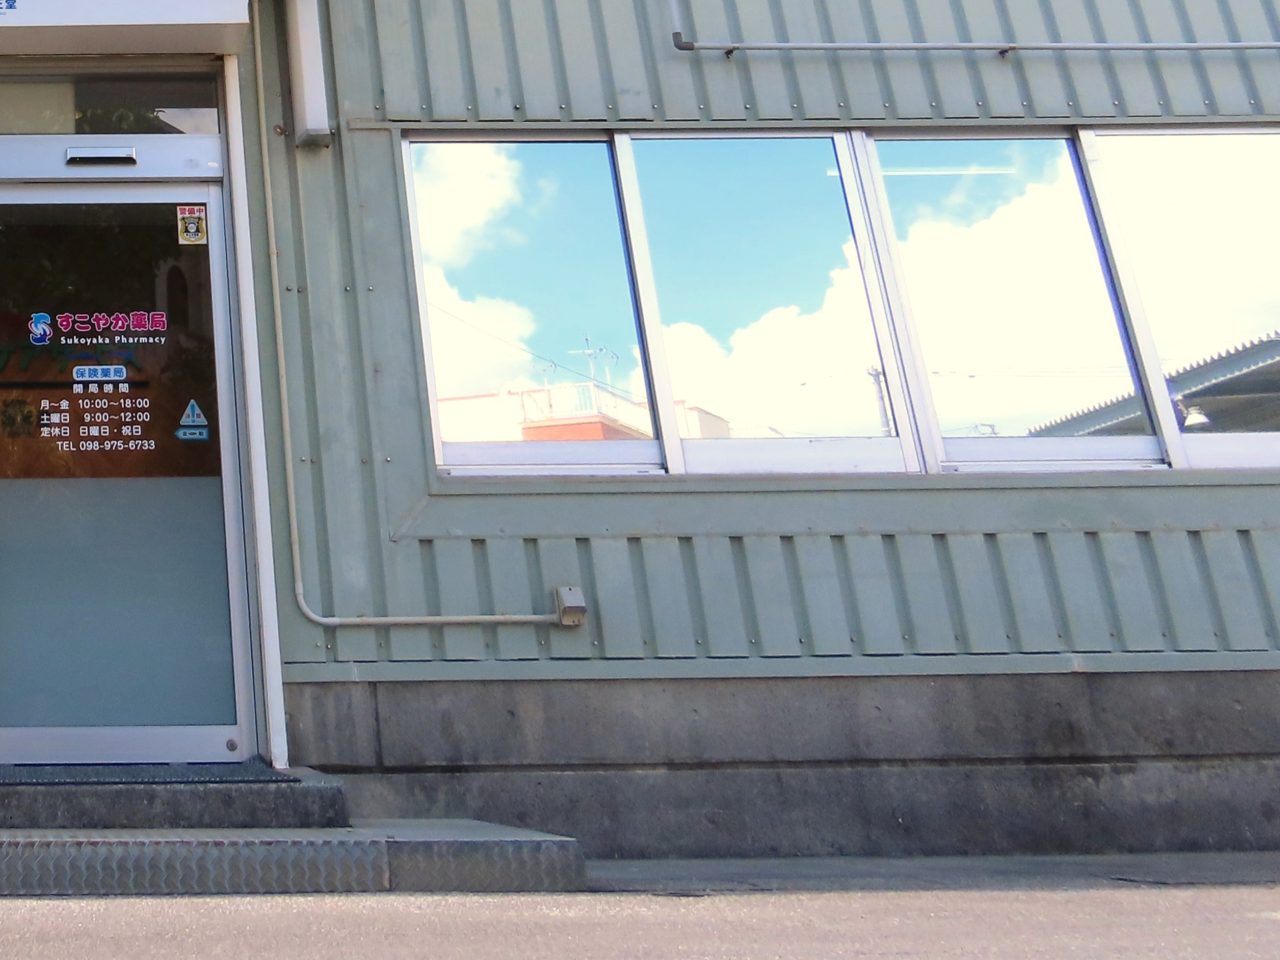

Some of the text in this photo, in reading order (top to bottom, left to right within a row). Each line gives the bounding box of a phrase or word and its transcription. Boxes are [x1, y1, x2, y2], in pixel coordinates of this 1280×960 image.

[56, 311, 168, 332] すこやか薬局
[60, 336, 166, 346] Sukoyaka Pharmacy
[75, 368, 124, 379] 保険薬局
[73, 384, 129, 394] 開局時間
[40, 413, 70, 424] 土曜日
[40, 427, 70, 437] 定休日
[56, 440, 156, 451] TEL 098-975-6733
